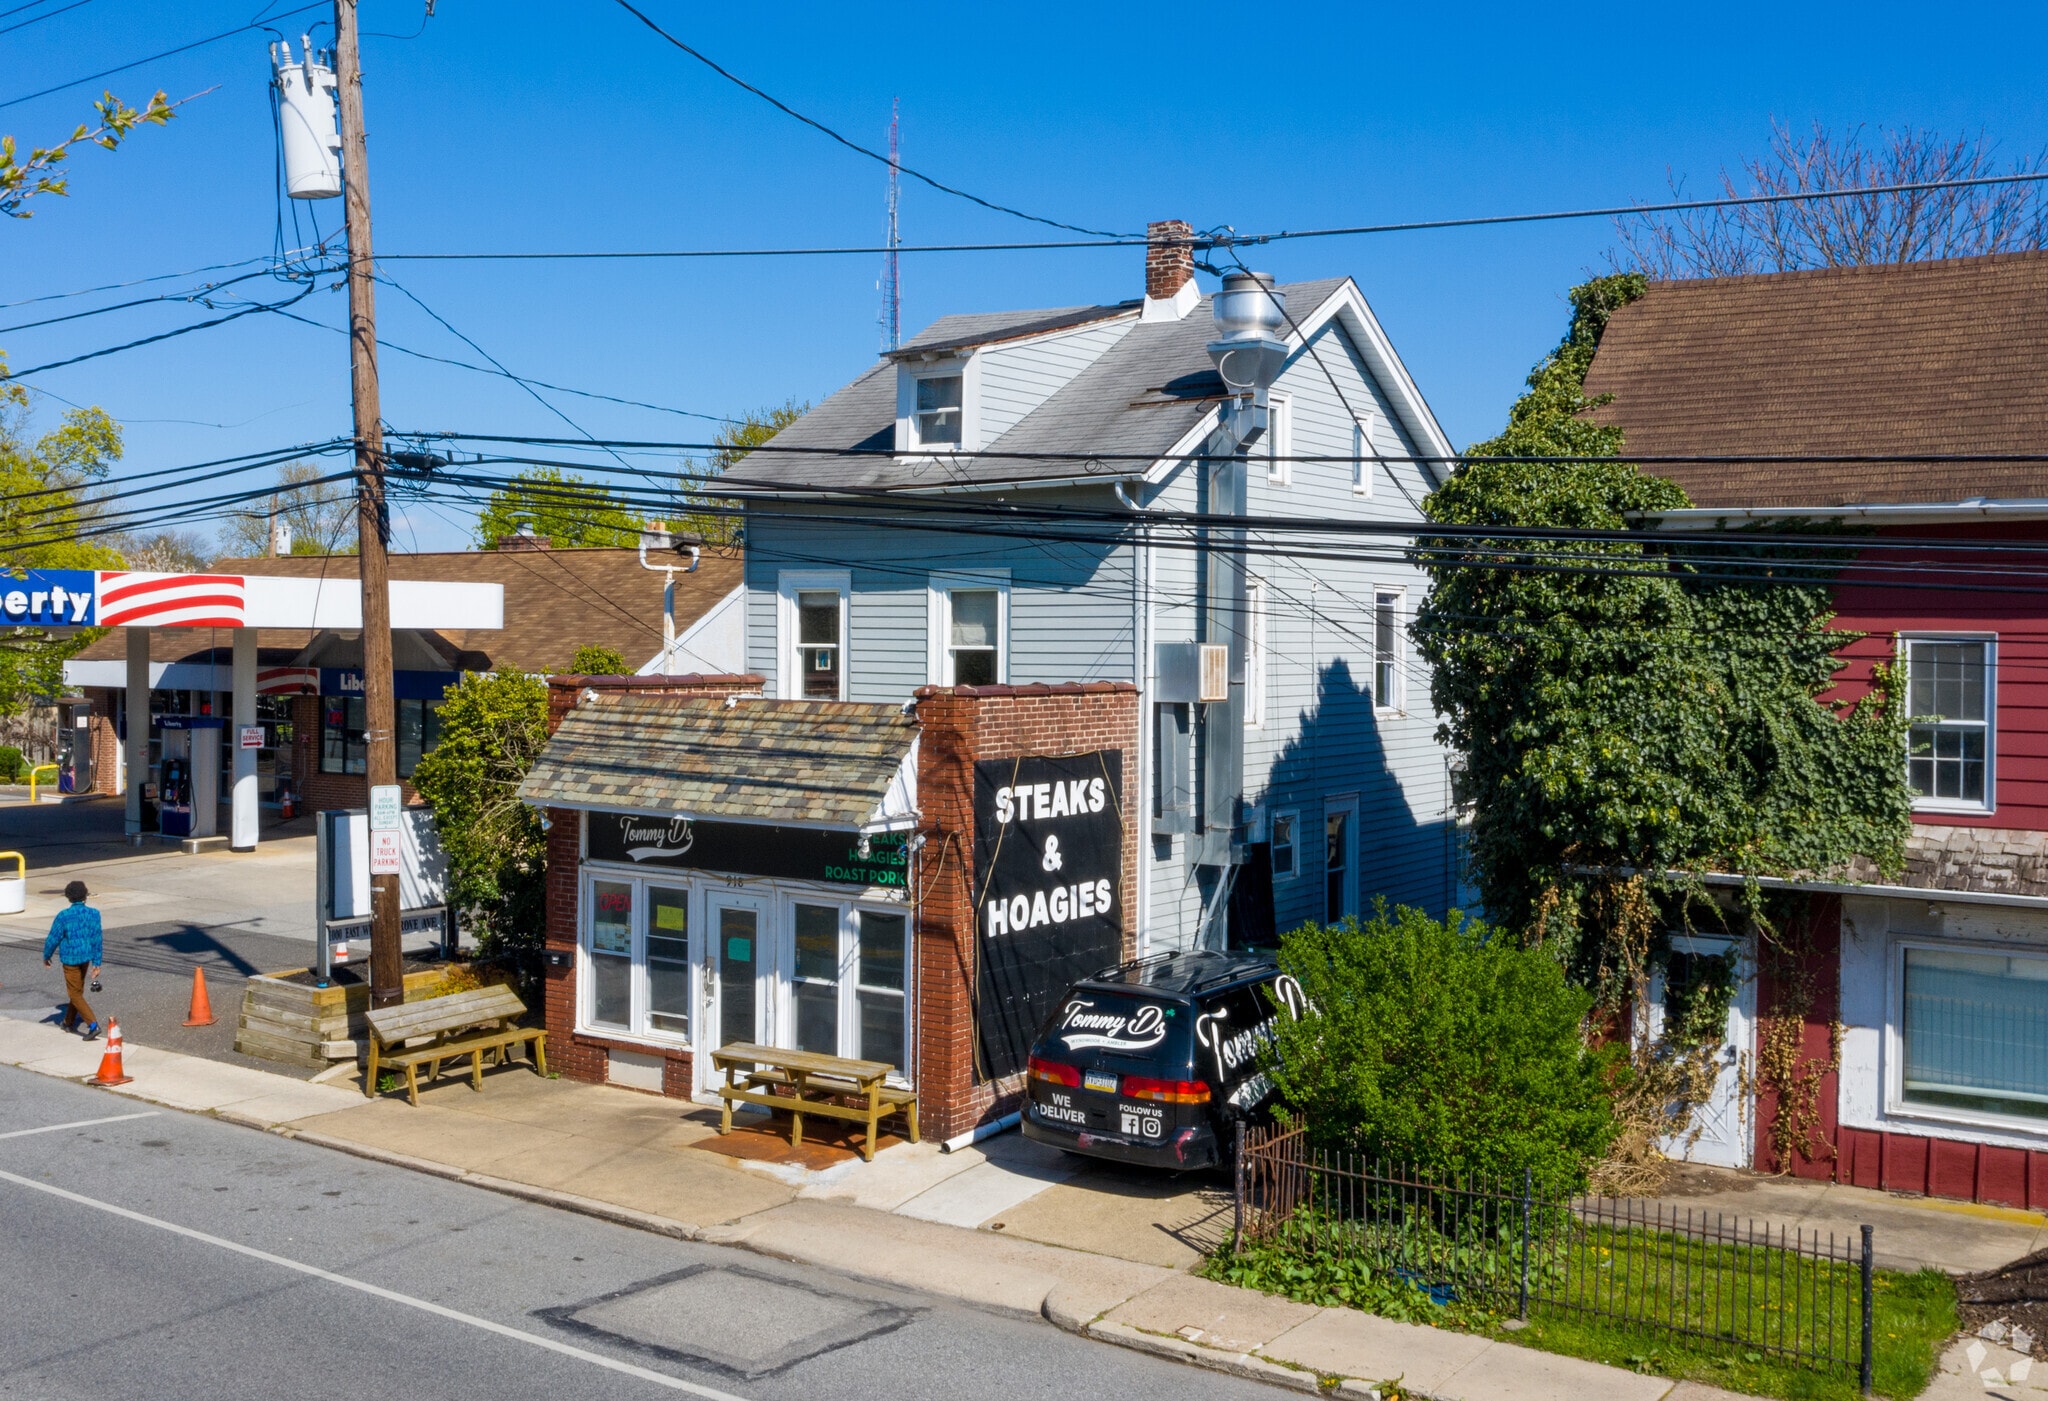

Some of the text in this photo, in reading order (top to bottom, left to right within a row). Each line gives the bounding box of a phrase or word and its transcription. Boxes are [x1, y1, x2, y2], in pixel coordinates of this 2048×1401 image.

[0, 586, 92, 622] erty
[995, 777, 1105, 824] STEAKS
[382, 836, 391, 846] NO
[620, 816, 666, 848] Tommy
[373, 857, 399, 866] PARKING
[376, 847, 396, 856] TRUCK
[848, 847, 907, 866] HAGIES
[1042, 834, 1063, 872] &
[825, 865, 906, 886] ROAST PORK
[600, 892, 632, 912] OPEN
[988, 878, 1112, 938] HOAGIES
[345, 926, 360, 939] EAST
[1062, 1000, 1126, 1038] Tommy
[1052, 1092, 1071, 1108] WE
[1040, 1103, 1086, 1125] DELIVER
[1119, 1103, 1163, 1118] FOLLOW US
